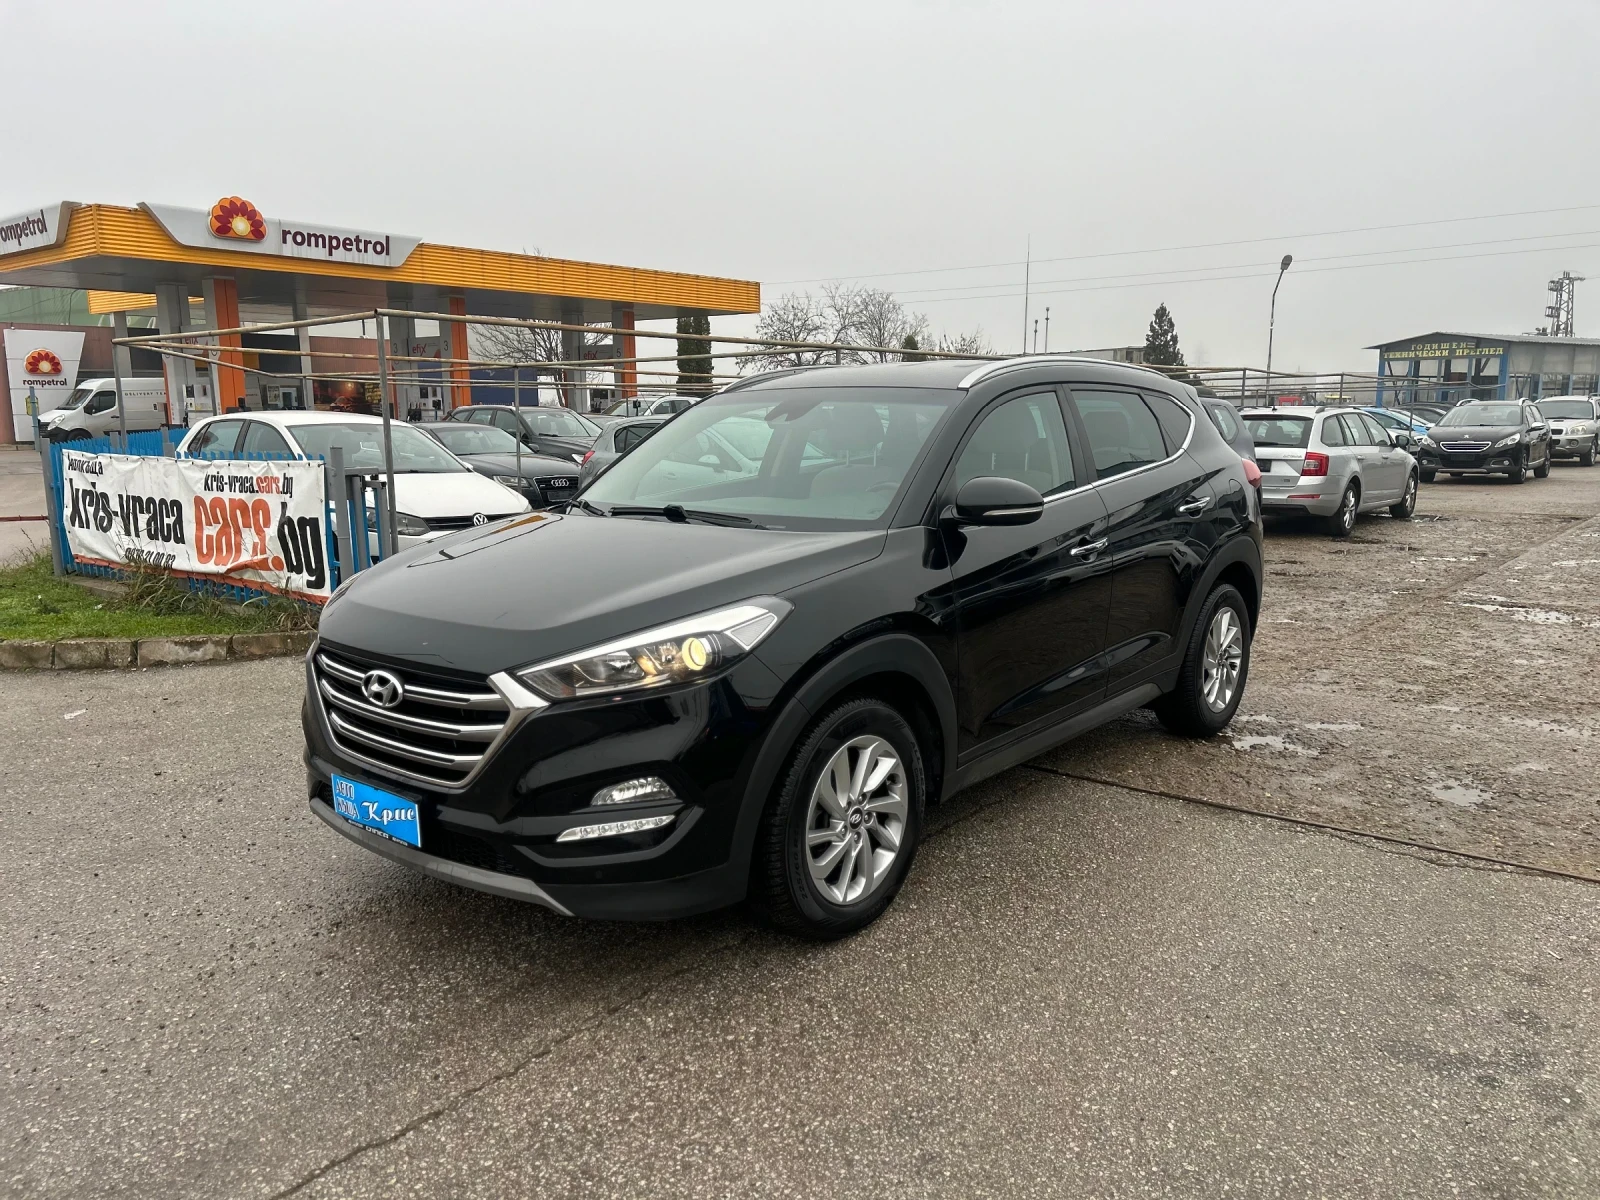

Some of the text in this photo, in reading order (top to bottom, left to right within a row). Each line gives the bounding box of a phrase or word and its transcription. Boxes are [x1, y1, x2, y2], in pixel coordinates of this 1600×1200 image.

[0, 209, 48, 246] ompetrol
[282, 229, 390, 256] rompetrol
[1384, 348, 1503, 359] ТЕХНИЧЕСКИ ПРЕГЛЕД
[1411, 342, 1467, 350] ГОДИШЕН
[23, 378, 67, 388] rompetrol
[204, 471, 294, 498] kris-vraca.cars.bg
[69, 478, 185, 544] kris-vraca
